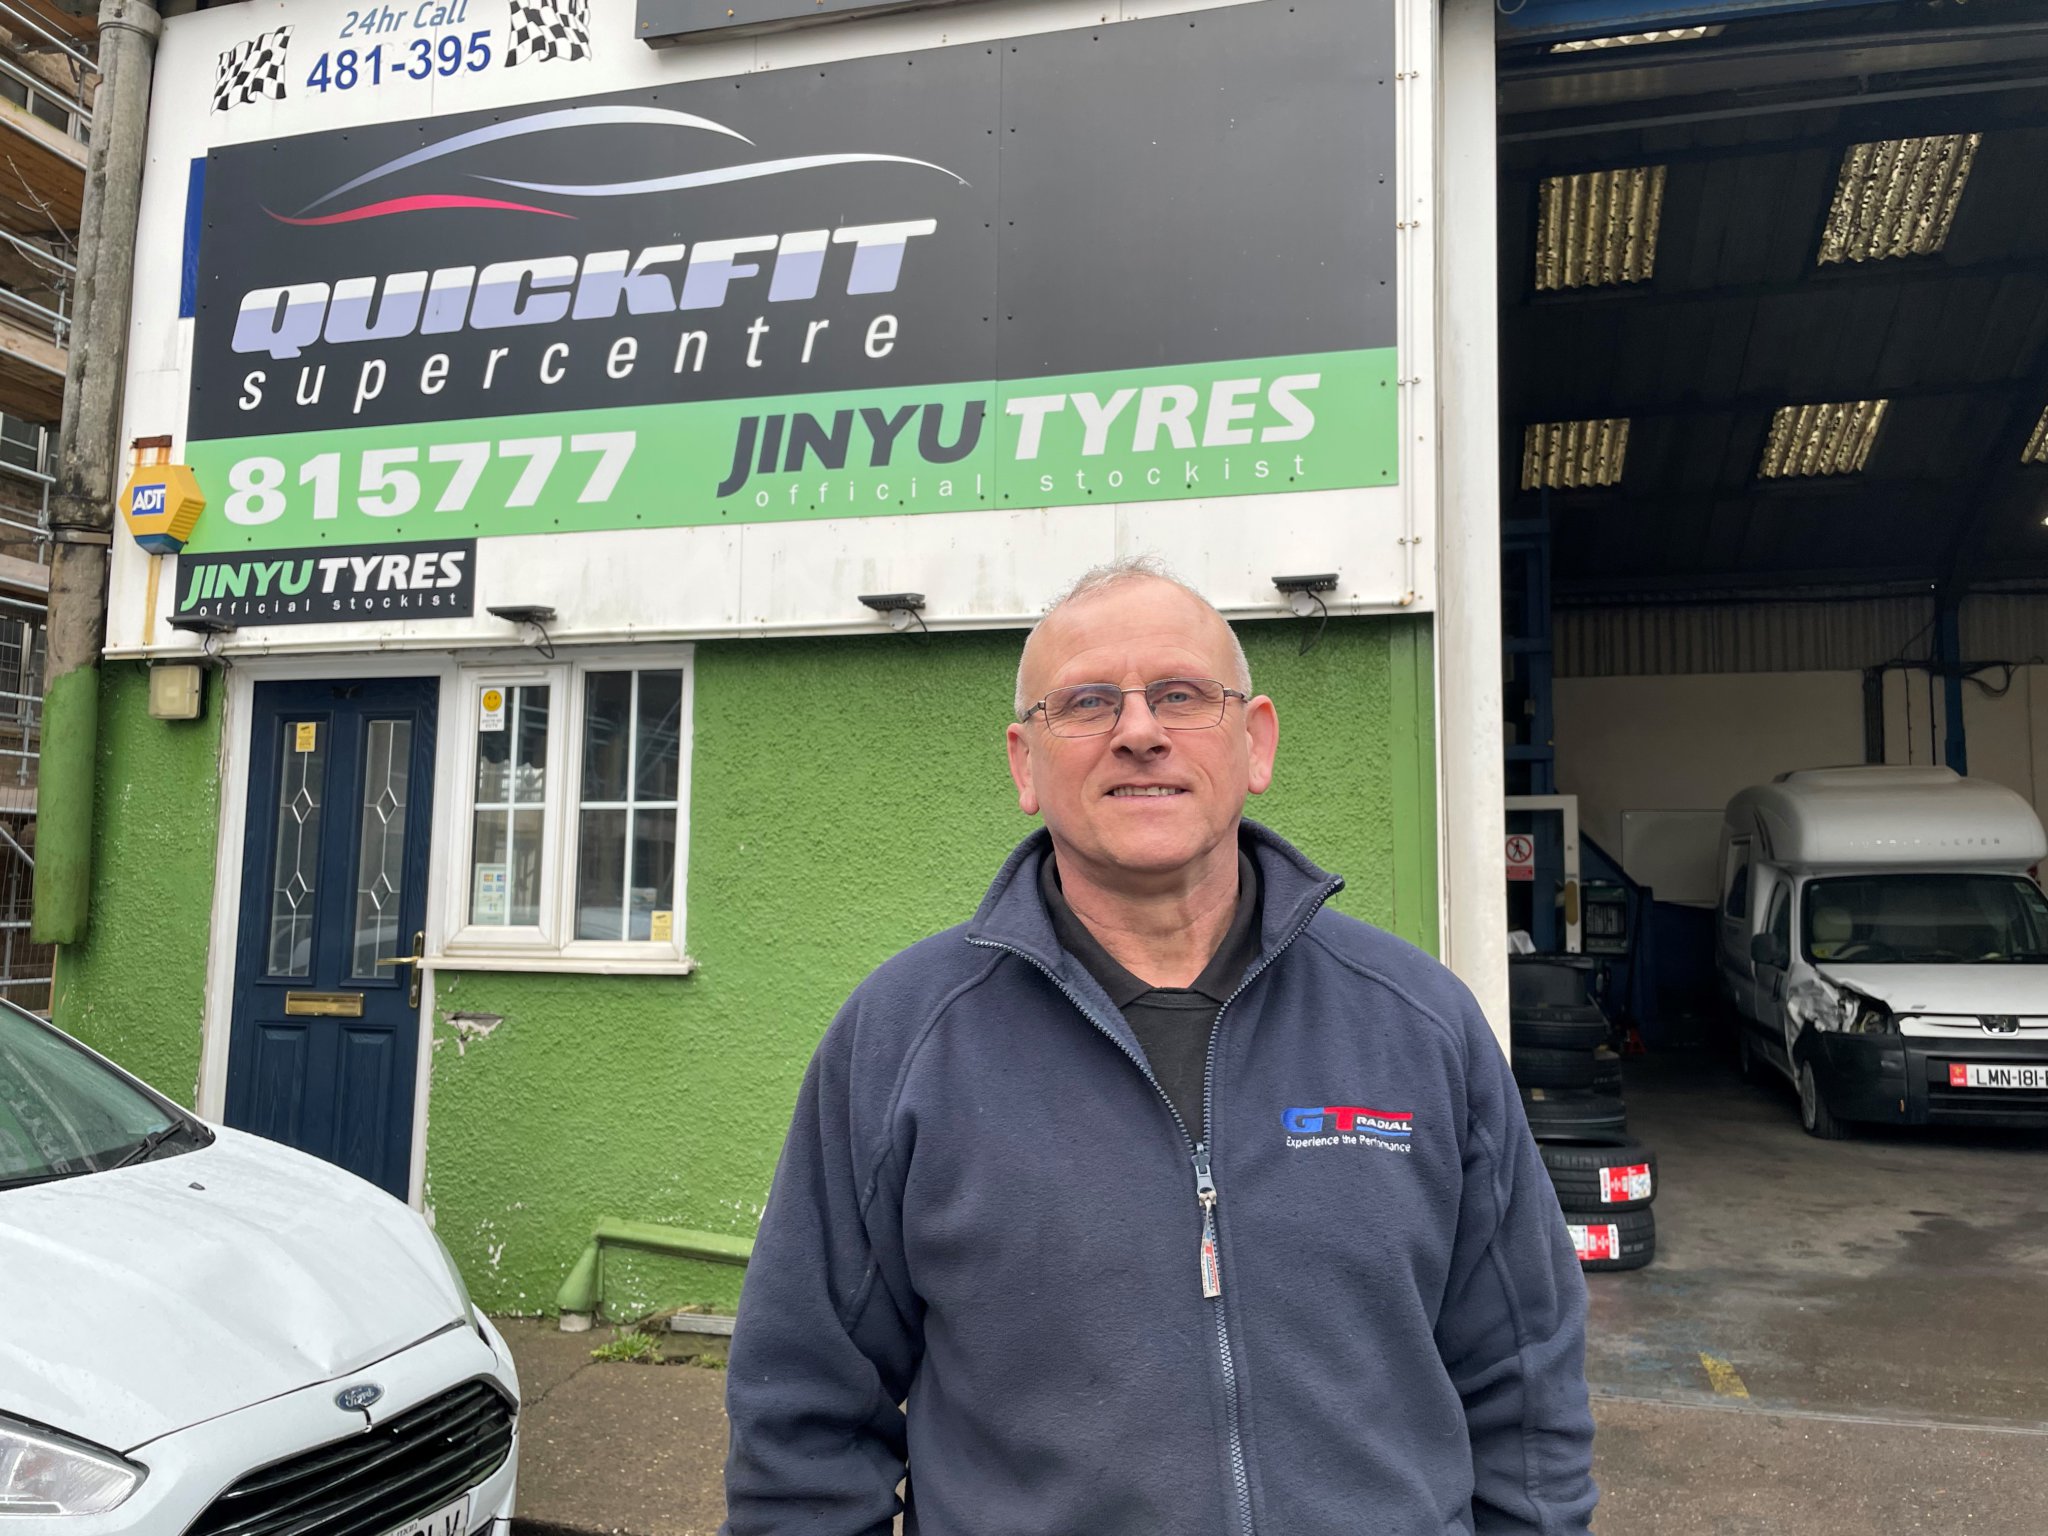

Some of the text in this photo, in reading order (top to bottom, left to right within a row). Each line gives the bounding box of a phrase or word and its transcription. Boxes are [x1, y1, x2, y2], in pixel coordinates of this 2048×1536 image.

[339, 0, 469, 39] 24hr Call
[306, 30, 491, 93] 481-395
[231, 219, 938, 359] QUICKFIT
[239, 314, 899, 414] supercentre
[716, 373, 1322, 498] JINYU TYRES
[223, 430, 637, 526] 815777
[755, 455, 1305, 507] official stockist
[132, 487, 165, 513] ADT
[180, 551, 466, 612] JINYU TYRES
[199, 593, 457, 617] official stockist
[1976, 1068, 2048, 1087] LMN-181-
[1282, 1106, 1413, 1133] GT
[1356, 1116, 1412, 1131] RADIAL
[1286, 1135, 1340, 1149] Experience
[1341, 1134, 1357, 1145] the
[345, 1387, 375, 1408] Ford
